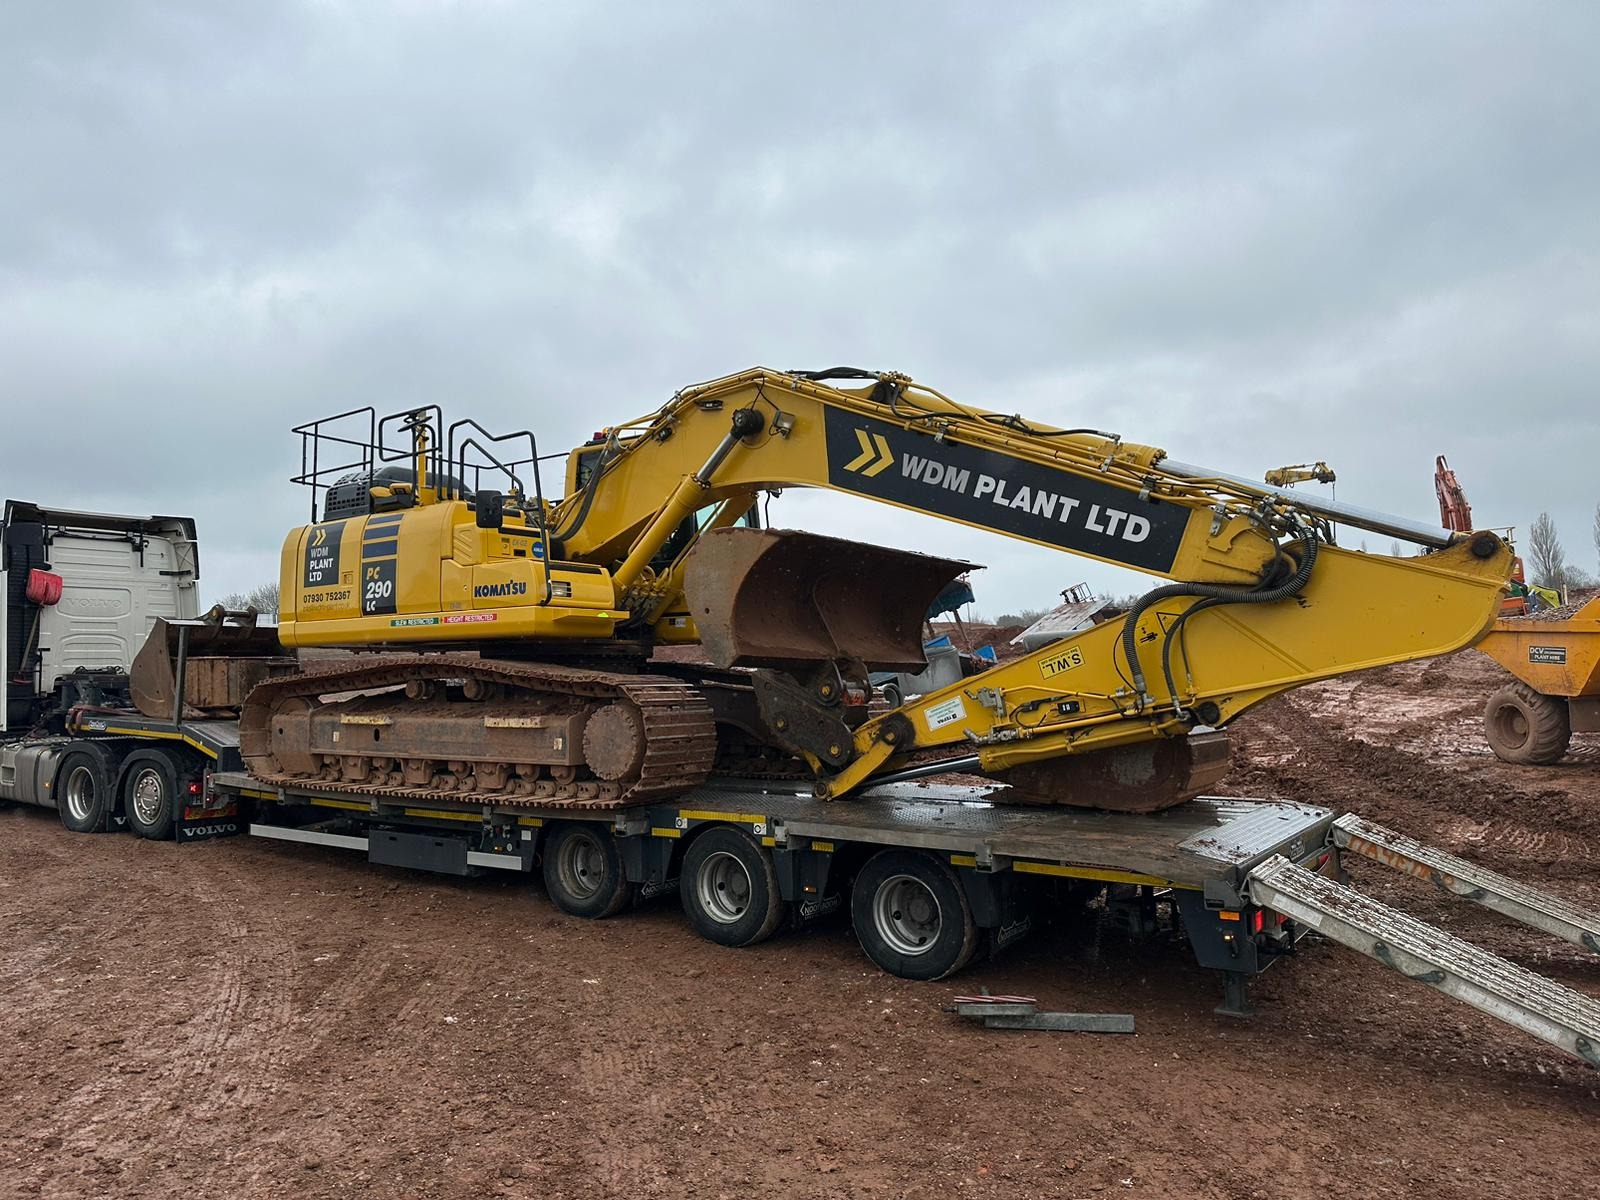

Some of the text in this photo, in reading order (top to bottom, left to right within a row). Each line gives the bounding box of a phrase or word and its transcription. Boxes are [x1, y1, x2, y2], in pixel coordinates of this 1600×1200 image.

[902, 453, 1151, 544] WDM PLANT LTD
[310, 546, 329, 559] WDM
[309, 558, 334, 570] PLANT
[309, 571, 323, 582] LTD
[366, 566, 381, 580] PC
[365, 580, 392, 599] 290
[474, 579, 527, 598] KOMATSU
[303, 590, 351, 603] 07930 752367
[366, 600, 377, 612] LC
[1042, 653, 1081, 673] S.W.L.
[183, 823, 237, 837] VOLVO
